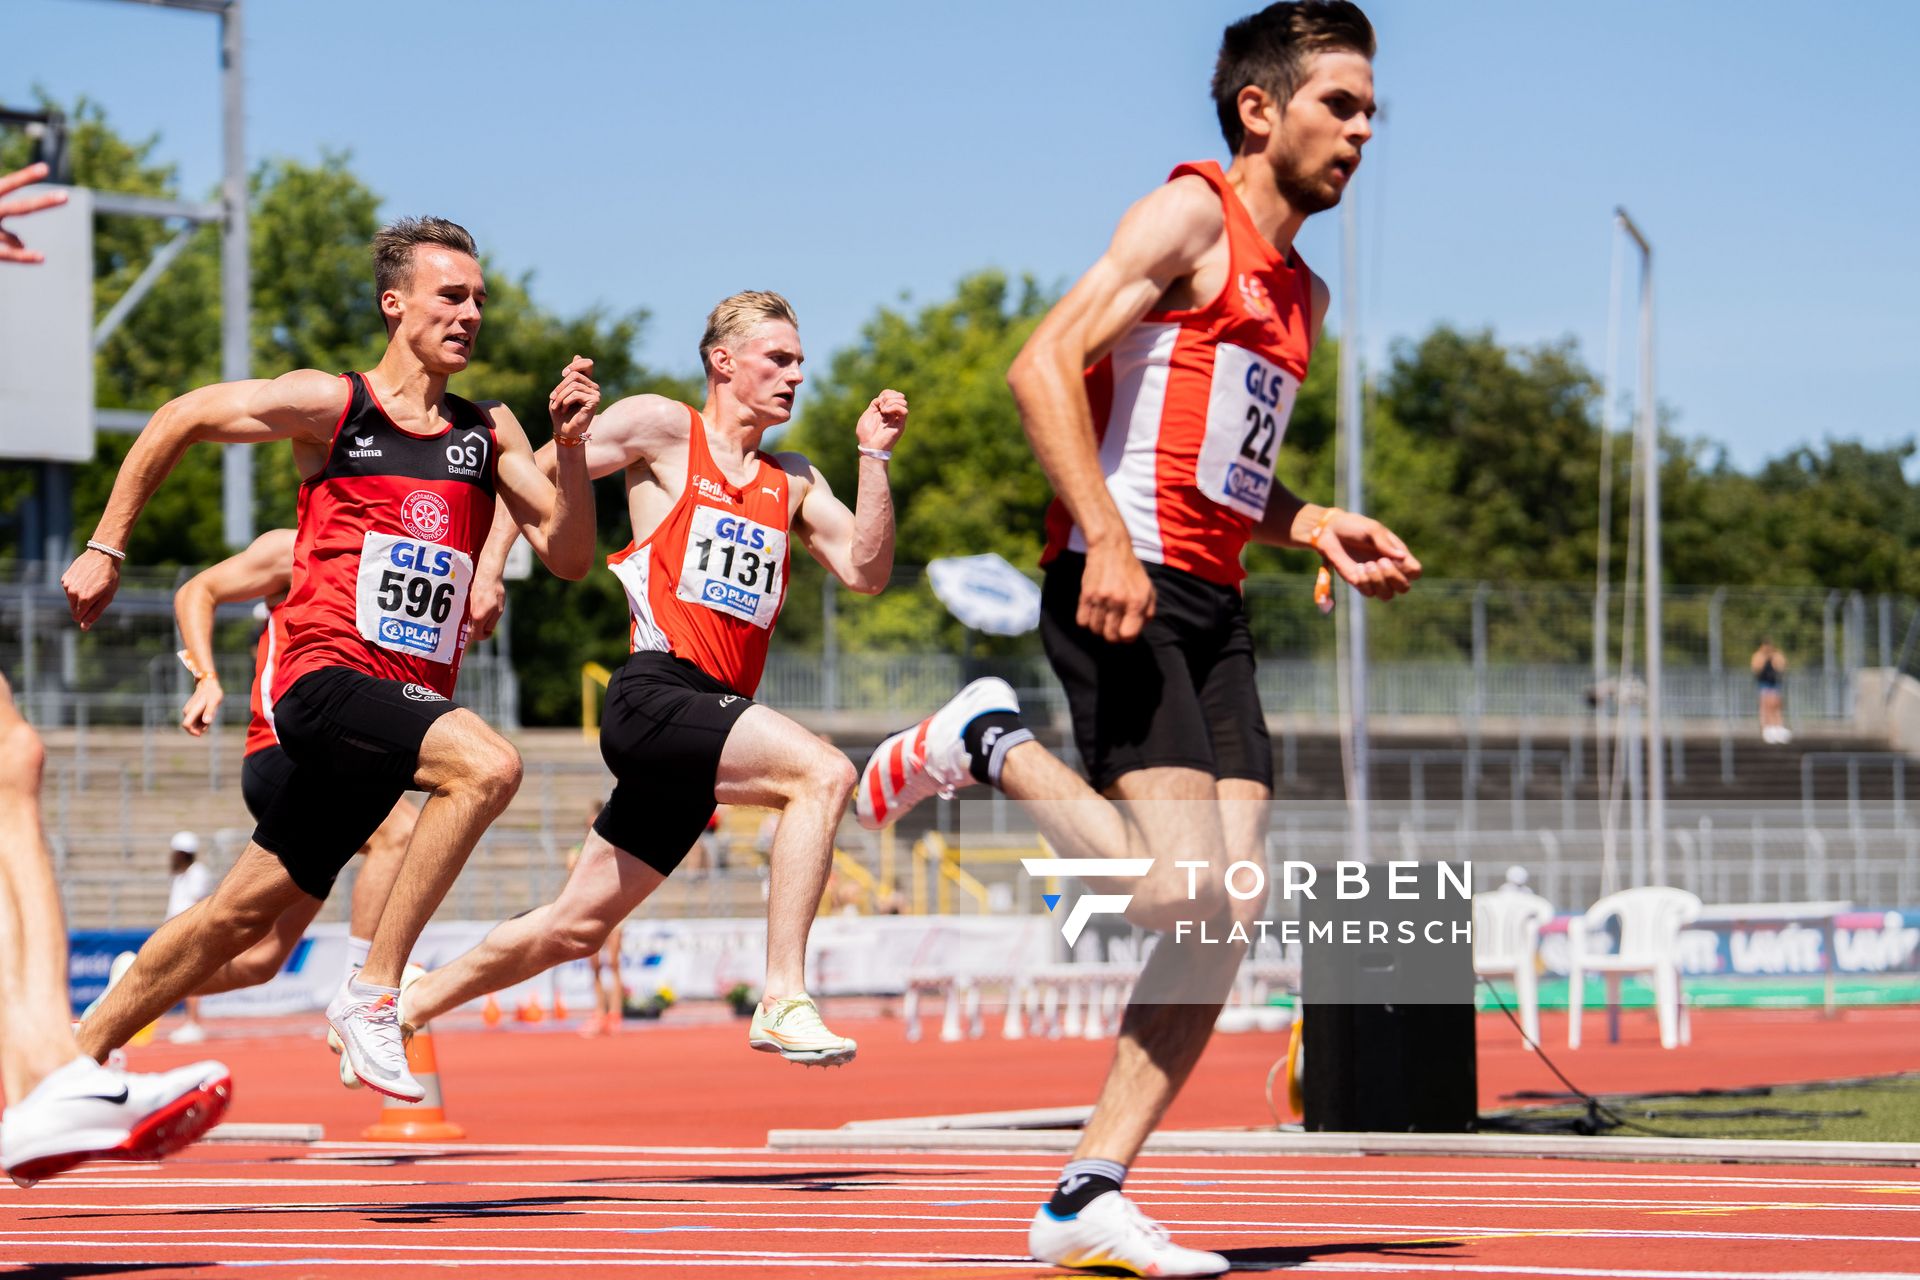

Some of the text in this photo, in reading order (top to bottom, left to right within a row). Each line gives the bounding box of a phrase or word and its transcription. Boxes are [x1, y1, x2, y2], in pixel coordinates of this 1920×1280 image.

[1245, 362, 1283, 409] GLS
[348, 448, 382, 458] erima
[1240, 405, 1276, 469] 22
[446, 445, 477, 467] OS
[716, 518, 765, 550] GLS
[390, 542, 453, 577] GLS
[695, 538, 776, 595] 1131
[377, 569, 455, 624] 596
[728, 588, 758, 608] PLAN
[405, 626, 438, 644] PLAN
